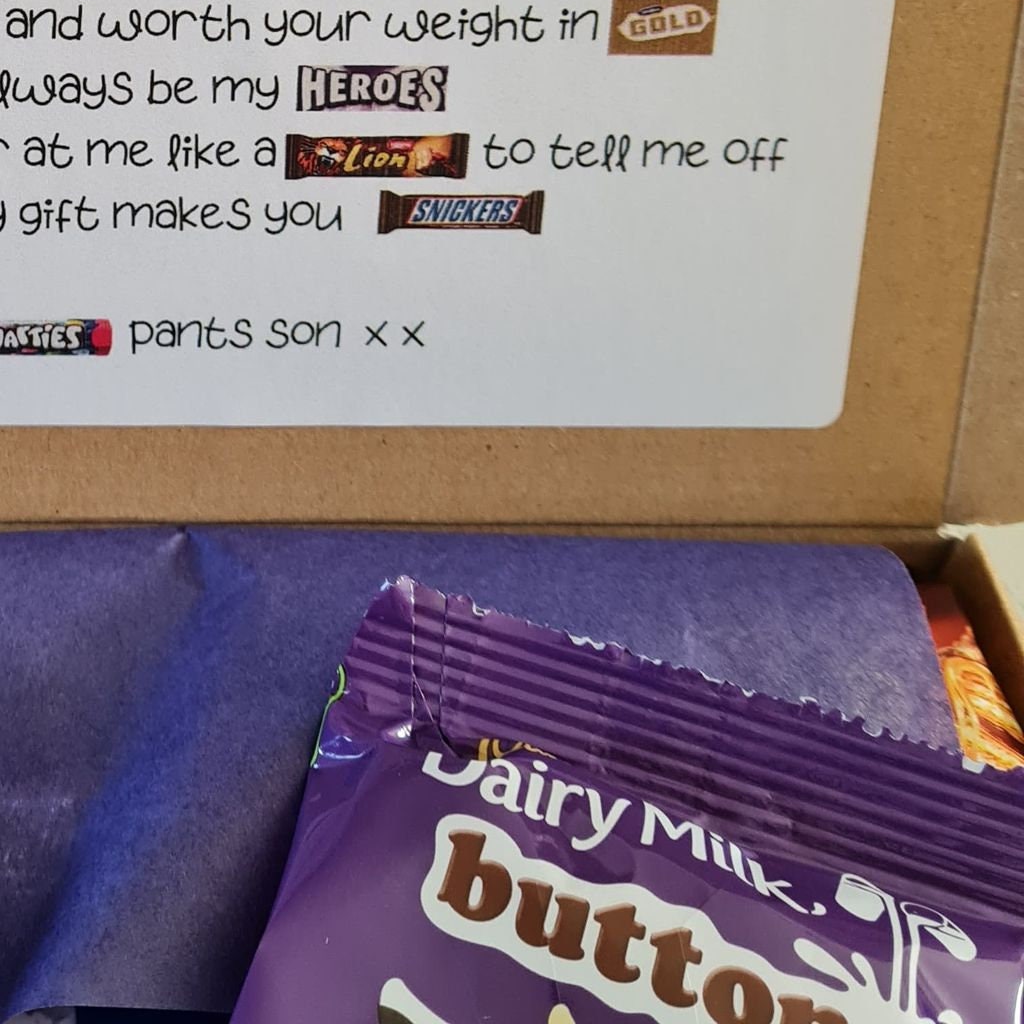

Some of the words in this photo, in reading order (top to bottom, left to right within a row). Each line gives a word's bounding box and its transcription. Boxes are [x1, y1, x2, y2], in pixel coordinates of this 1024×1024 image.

[6, 4, 83, 40] and
[97, 4, 250, 42] worth
[264, 10, 371, 46] your
[384, 5, 544, 47] weight
[559, 8, 599, 40] in
[630, 10, 703, 35] GOLD
[147, 69, 198, 105] be
[212, 75, 279, 110] my
[300, 66, 445, 111] HEROES
[24, 133, 73, 169] at
[87, 139, 153, 167] me
[167, 133, 240, 172] like
[254, 137, 276, 167] a
[343, 144, 407, 172] Lion
[483, 134, 535, 169] to
[549, 134, 630, 172] tell
[642, 140, 709, 168] me
[723, 137, 788, 172] off
[19, 196, 99, 235] gift
[113, 196, 251, 231] makes
[264, 201, 342, 235] you
[412, 199, 519, 222] SNICKERS
[129, 317, 253, 354] pants
[265, 318, 341, 349] son
